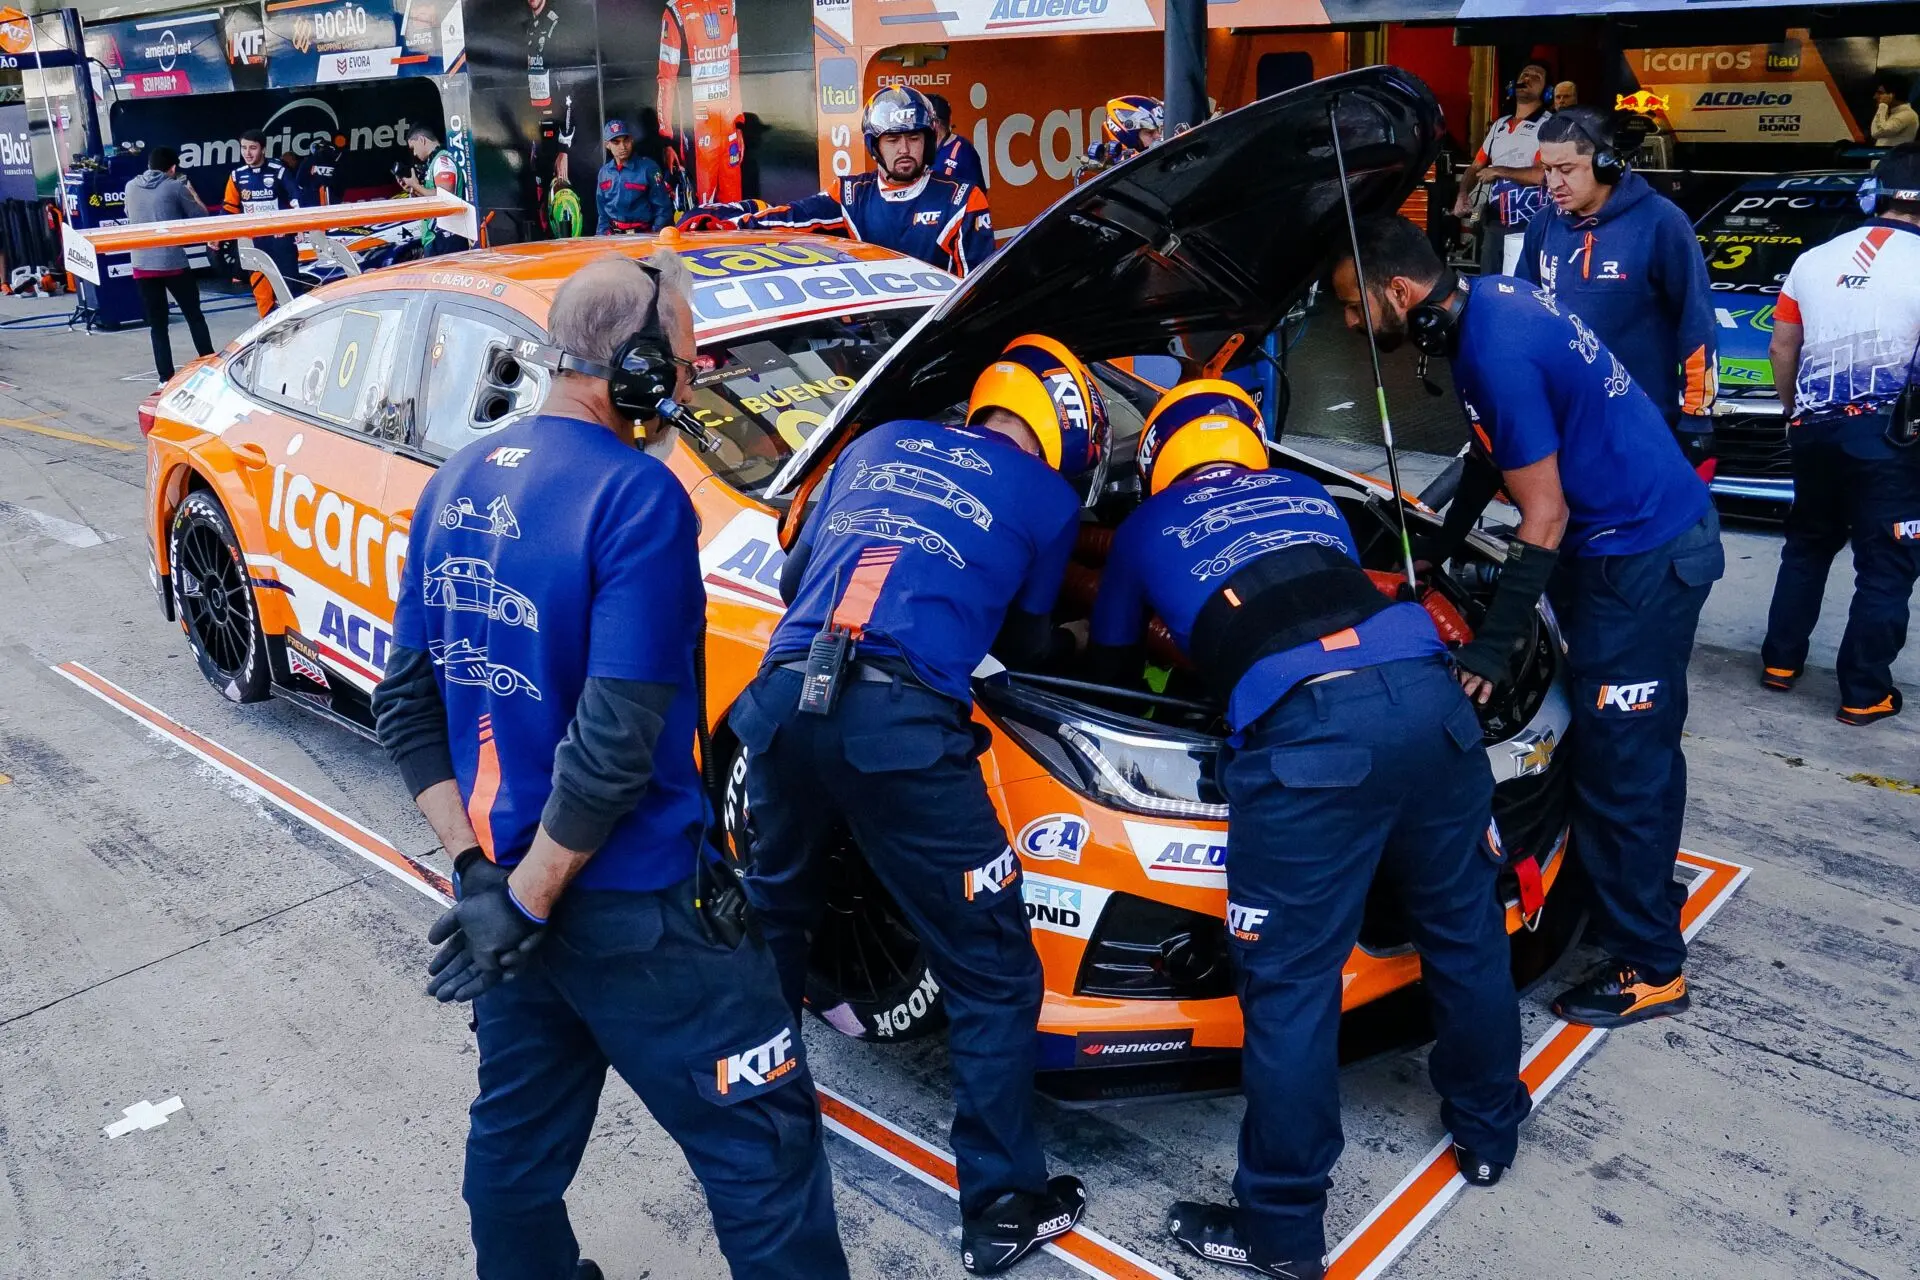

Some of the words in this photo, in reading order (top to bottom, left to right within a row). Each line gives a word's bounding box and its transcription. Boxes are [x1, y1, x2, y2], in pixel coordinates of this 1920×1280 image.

[314, 2, 367, 39] BOCÃO
[233, 29, 264, 65] KTF
[349, 56, 371, 69] EVORA
[1643, 49, 1752, 71] icarros
[1768, 54, 1799, 67] Itaú
[877, 73, 951, 88] CHEVROLET
[822, 84, 857, 106] Itaú
[1695, 91, 1793, 107] ACDelco
[1758, 123, 1800, 132] BOND
[1760, 115, 1800, 124] TEK
[916, 210, 942, 225] KTF
[1714, 235, 1803, 245] BAPTISTA
[67, 248, 94, 269] ACDelco
[1712, 245, 1752, 270] 3
[441, 274, 474, 288] BUENO
[1839, 274, 1871, 290] KTF
[691, 268, 957, 324] CDelco
[519, 338, 540, 358] KTF
[338, 341, 358, 388] 0
[740, 375, 857, 415] BUENO
[1049, 372, 1088, 430] KTF
[493, 446, 531, 468] KTF
[287, 634, 318, 662] FREMAX
[1606, 681, 1659, 712] KTF
[1631, 701, 1655, 711] SPORTS
[1028, 821, 1081, 852] CBA
[973, 845, 1014, 894] KTF
[1235, 929, 1260, 942] SPORTS
[727, 1027, 793, 1087] KTF
[765, 1057, 797, 1083] SPORTS
[1037, 1213, 1071, 1236] sparco
[1203, 1242, 1247, 1260] sparco
